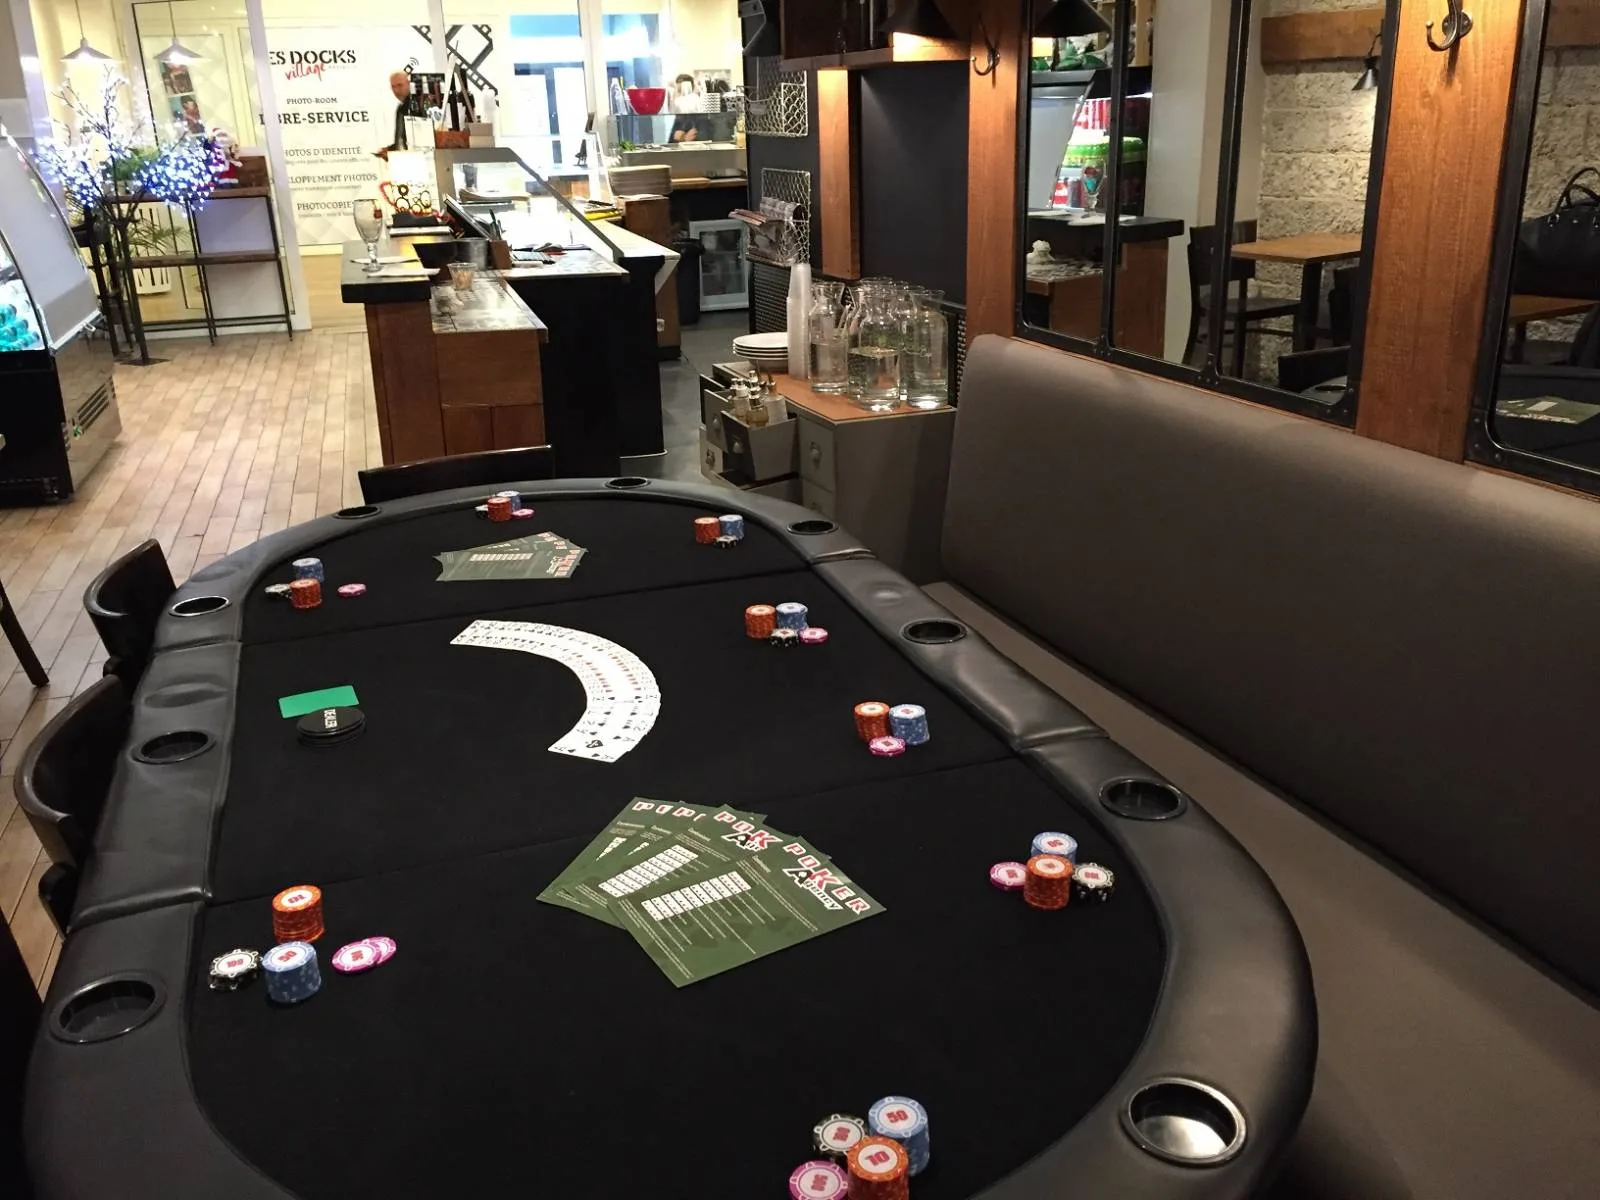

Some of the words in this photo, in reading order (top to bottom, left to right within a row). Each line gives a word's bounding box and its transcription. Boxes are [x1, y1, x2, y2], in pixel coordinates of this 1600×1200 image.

[268, 50, 286, 65] ES
[289, 50, 357, 64] DOCKS
[285, 62, 326, 82] village
[286, 97, 338, 105] PHOTO-ROOM
[258, 111, 370, 125] LRE-SERVICE
[344, 173, 378, 182] PHOTOS
[713, 811, 783, 849] POK
[782, 842, 871, 915] POKER
[886, 1110, 908, 1123] 50
[865, 1151, 890, 1166] 10
